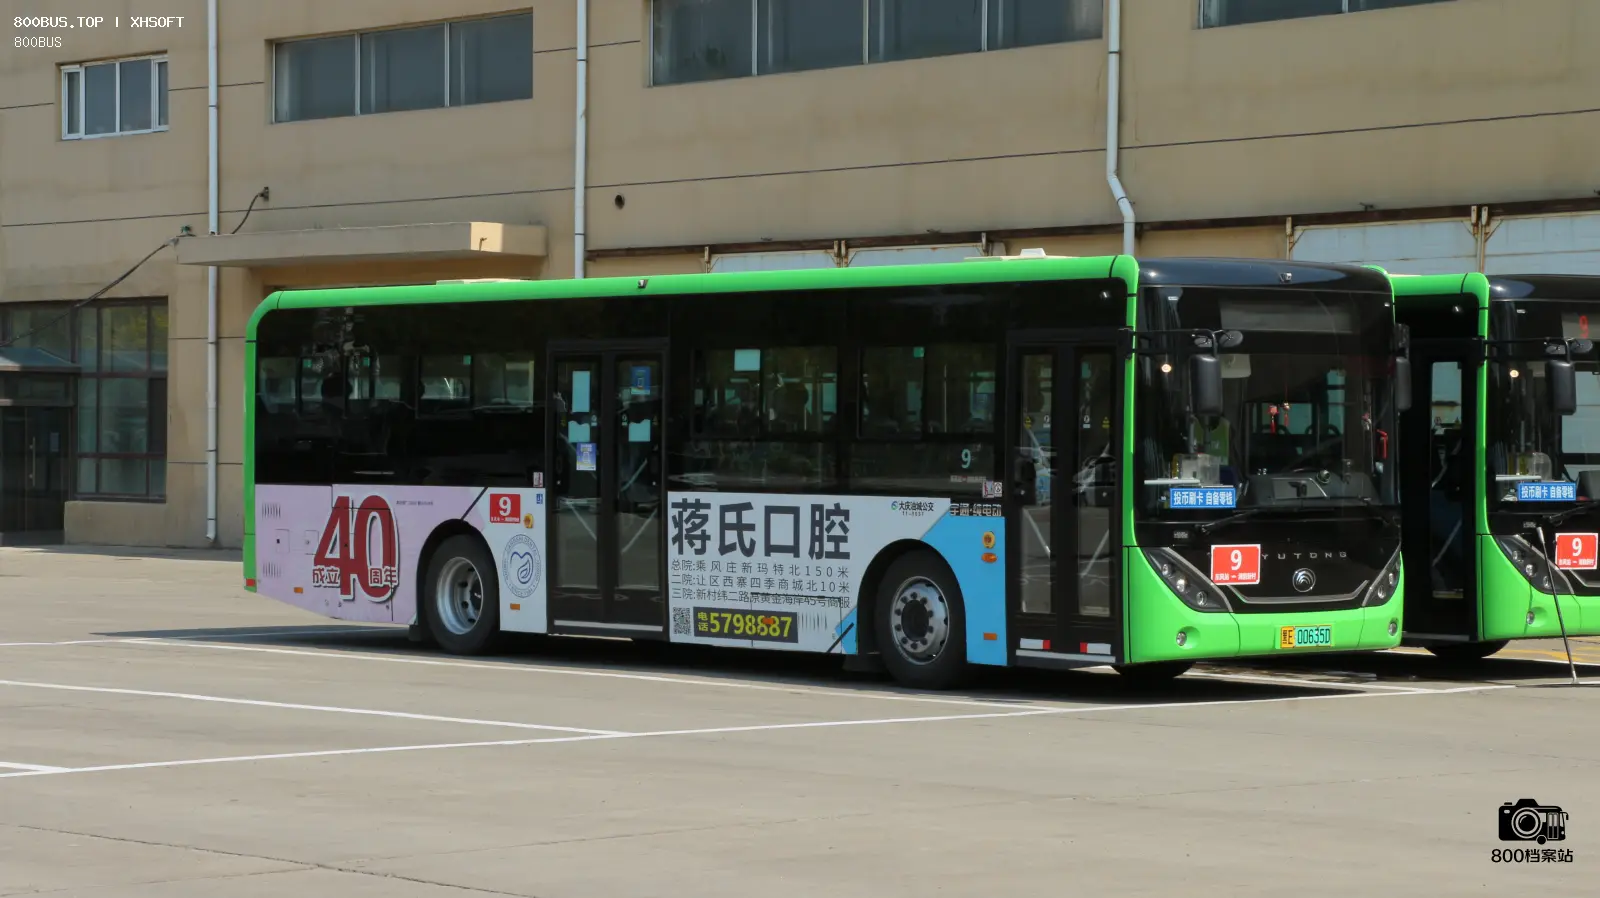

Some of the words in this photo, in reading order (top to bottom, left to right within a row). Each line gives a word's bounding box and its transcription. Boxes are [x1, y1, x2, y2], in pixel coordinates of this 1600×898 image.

[961, 448, 972, 469] 9
[1173, 491, 1204, 506] 投币刷卡
[1205, 491, 1233, 506] 自备零钱
[1521, 485, 1549, 499] 投币刷卡
[1550, 485, 1574, 499] 自备零钱
[498, 496, 512, 517] 9
[671, 498, 851, 560] 蒋氏口腔
[313, 494, 397, 598] 40
[1261, 550, 1348, 561] YUTONG
[1571, 537, 1583, 557] 9
[1230, 549, 1243, 571] 9
[312, 567, 340, 585] 成立
[369, 566, 398, 585] 周年
[697, 611, 709, 633] 电话
[709, 612, 793, 639] 5798887
